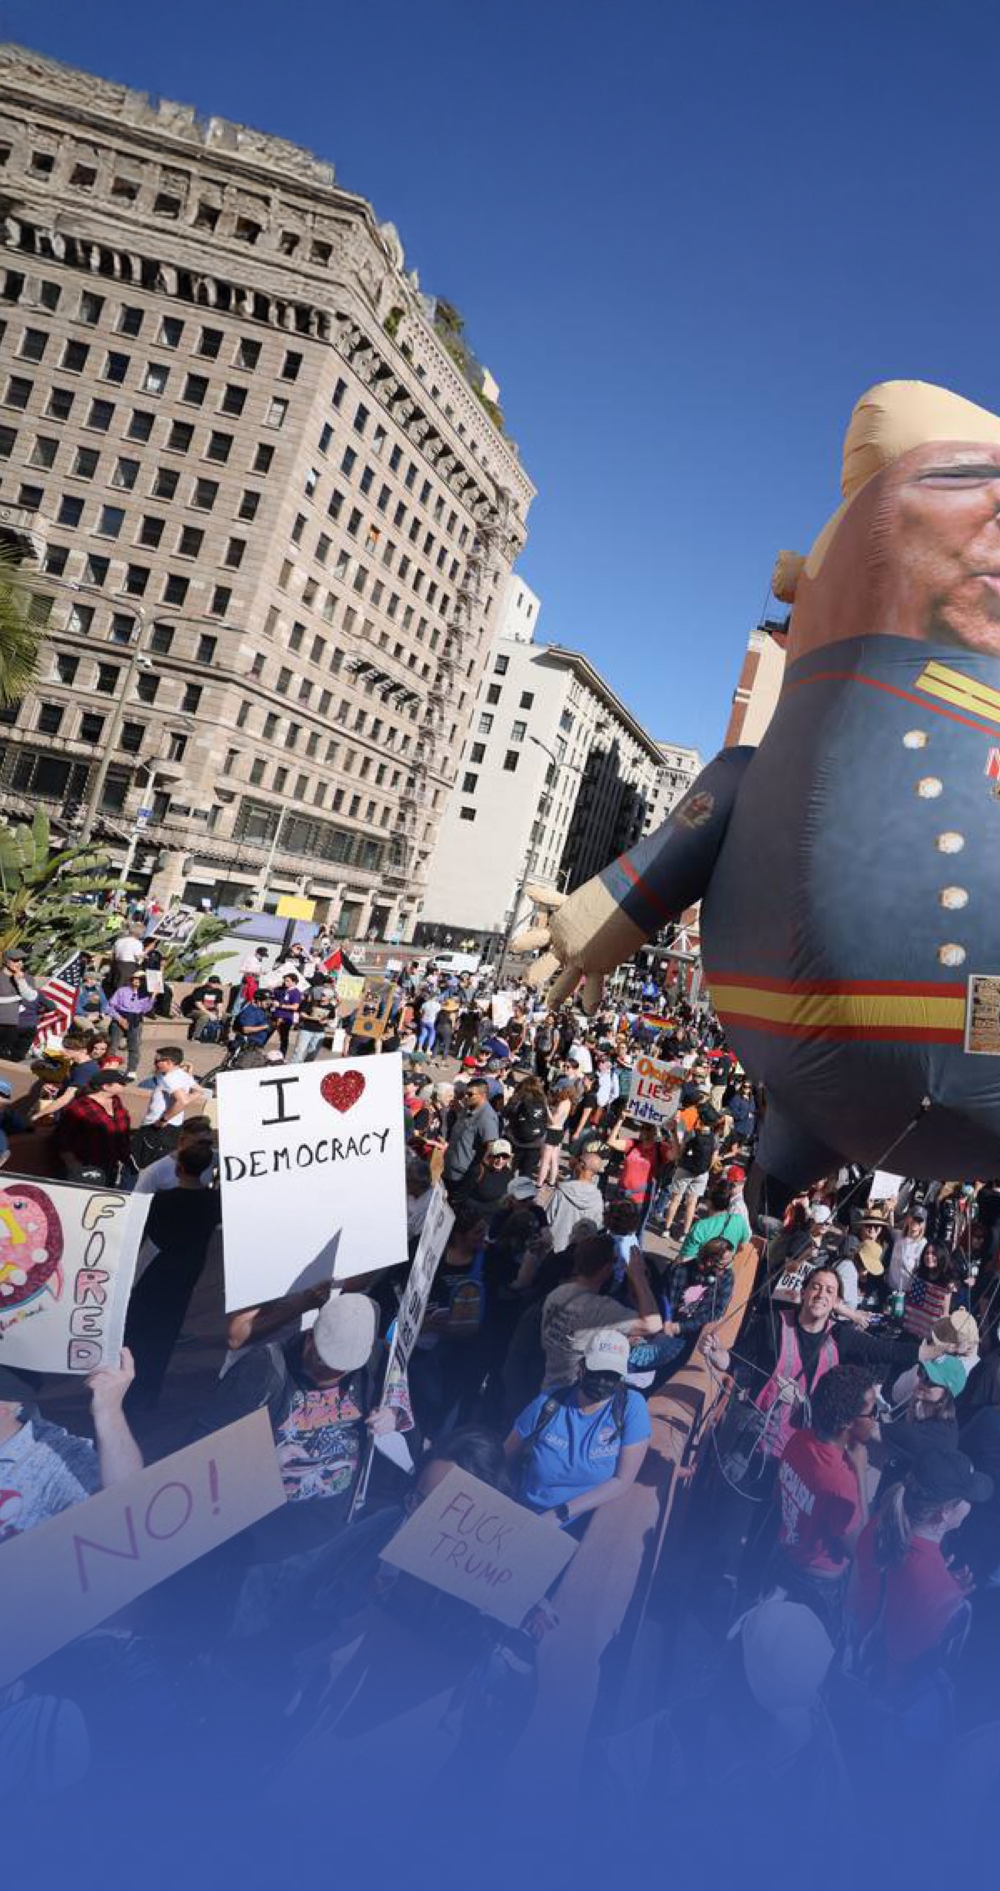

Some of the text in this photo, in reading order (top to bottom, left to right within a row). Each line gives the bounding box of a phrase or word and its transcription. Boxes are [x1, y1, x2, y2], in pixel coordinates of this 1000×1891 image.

[259, 1076, 300, 1126] I
[629, 1099, 667, 1122] Matter
[637, 1079, 673, 1102] LIES
[225, 1128, 391, 1182] DEMOCRACY
[67, 1194, 126, 1371] FIRED
[72, 1459, 221, 1593] NO!
[439, 1491, 515, 1551] FUCK
[431, 1533, 512, 1588] TRUMP
